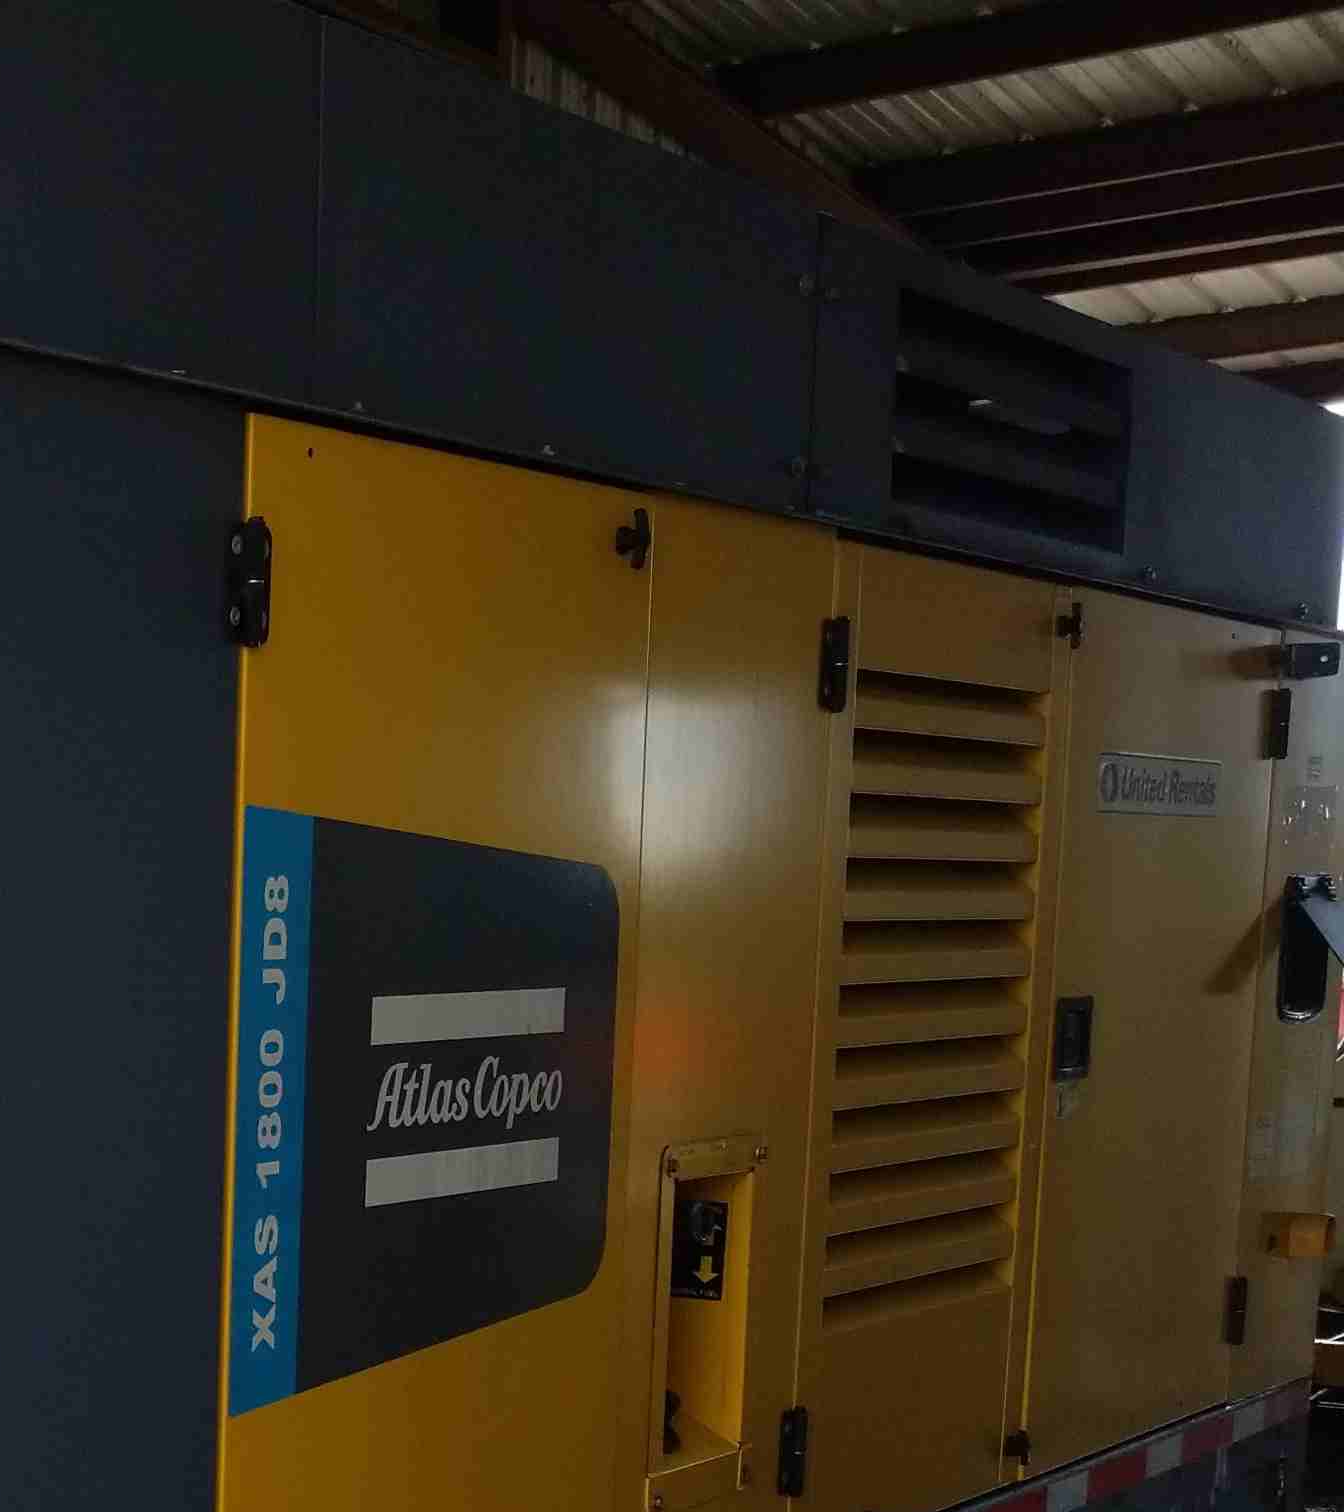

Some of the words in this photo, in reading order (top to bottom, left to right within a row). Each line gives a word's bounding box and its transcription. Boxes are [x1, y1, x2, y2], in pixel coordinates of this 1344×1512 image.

[1120, 766, 1166, 802] United
[262, 874, 289, 1005] JD8
[256, 1028, 285, 1190] 1800
[367, 1062, 472, 1132] Atlas
[473, 1055, 562, 1129] Copco
[252, 1214, 278, 1352] XAS
